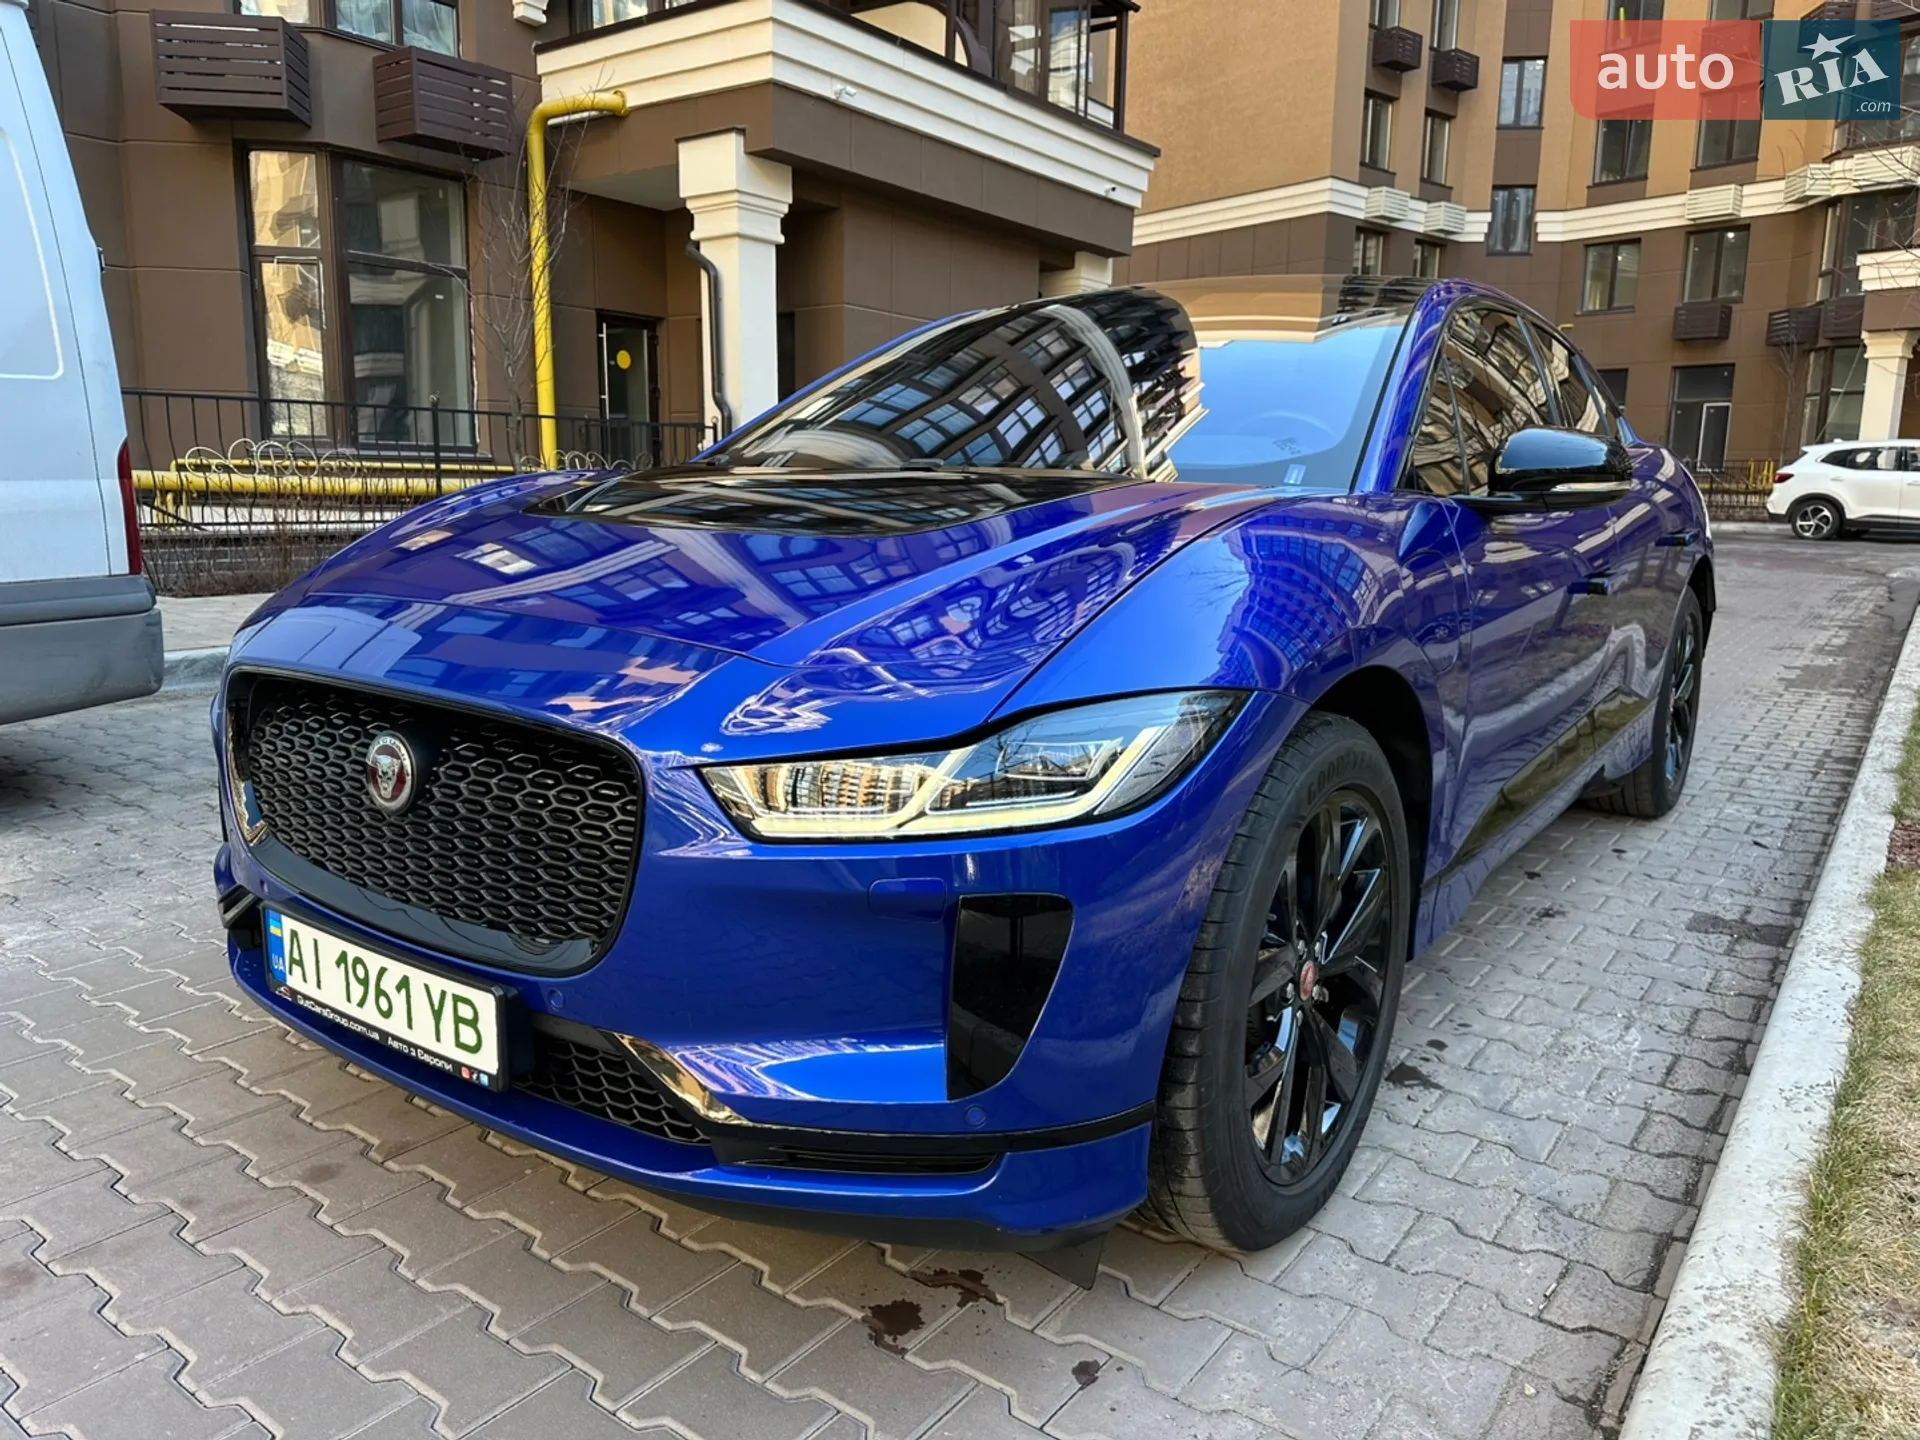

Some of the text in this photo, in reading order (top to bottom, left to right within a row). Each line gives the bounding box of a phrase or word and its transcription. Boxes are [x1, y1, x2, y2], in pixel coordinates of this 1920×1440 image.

[271, 954, 286, 972] UA
[288, 928, 482, 1055] AI 1961 YB
[387, 1036, 409, 1053] Авто
